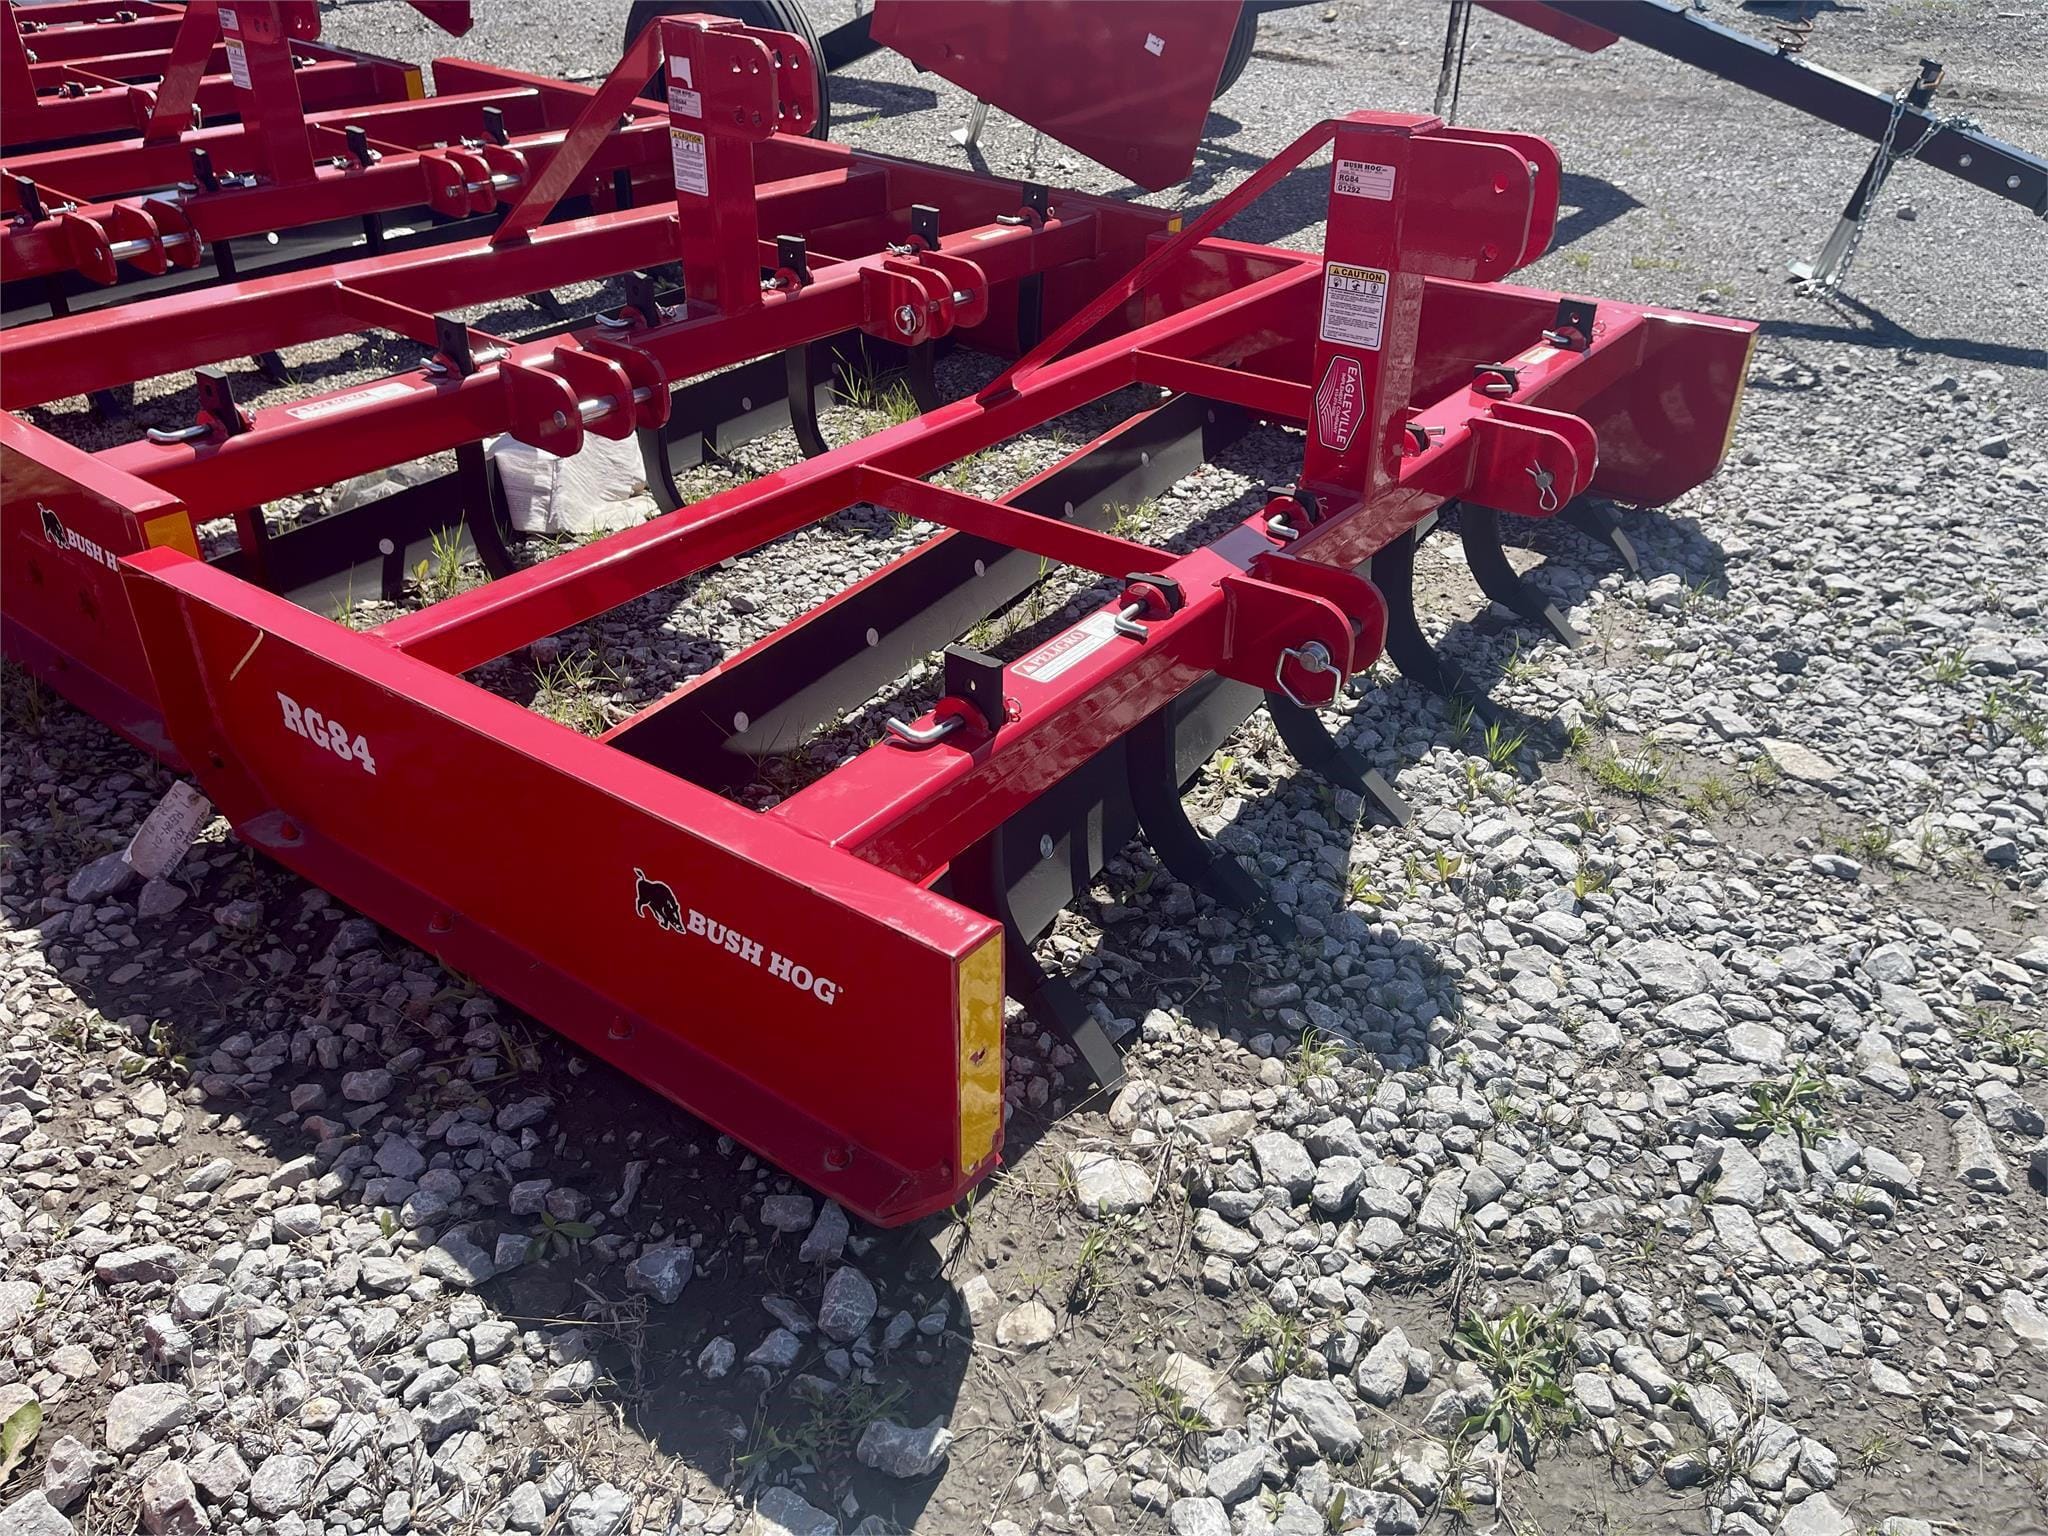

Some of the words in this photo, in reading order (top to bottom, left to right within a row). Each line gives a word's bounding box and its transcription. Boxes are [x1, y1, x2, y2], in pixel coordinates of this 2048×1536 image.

[1339, 174, 1359, 183] RG84
[1343, 161, 1363, 169] BUSH
[1364, 164, 1382, 172] HOG
[1341, 268, 1382, 282] CAUTION
[1336, 366, 1358, 444] EAGLEVILLE
[66, 527, 104, 564] BUSH
[1033, 631, 1085, 667] PELIGRO
[276, 690, 377, 776] RG84
[687, 908, 764, 966] BUSH
